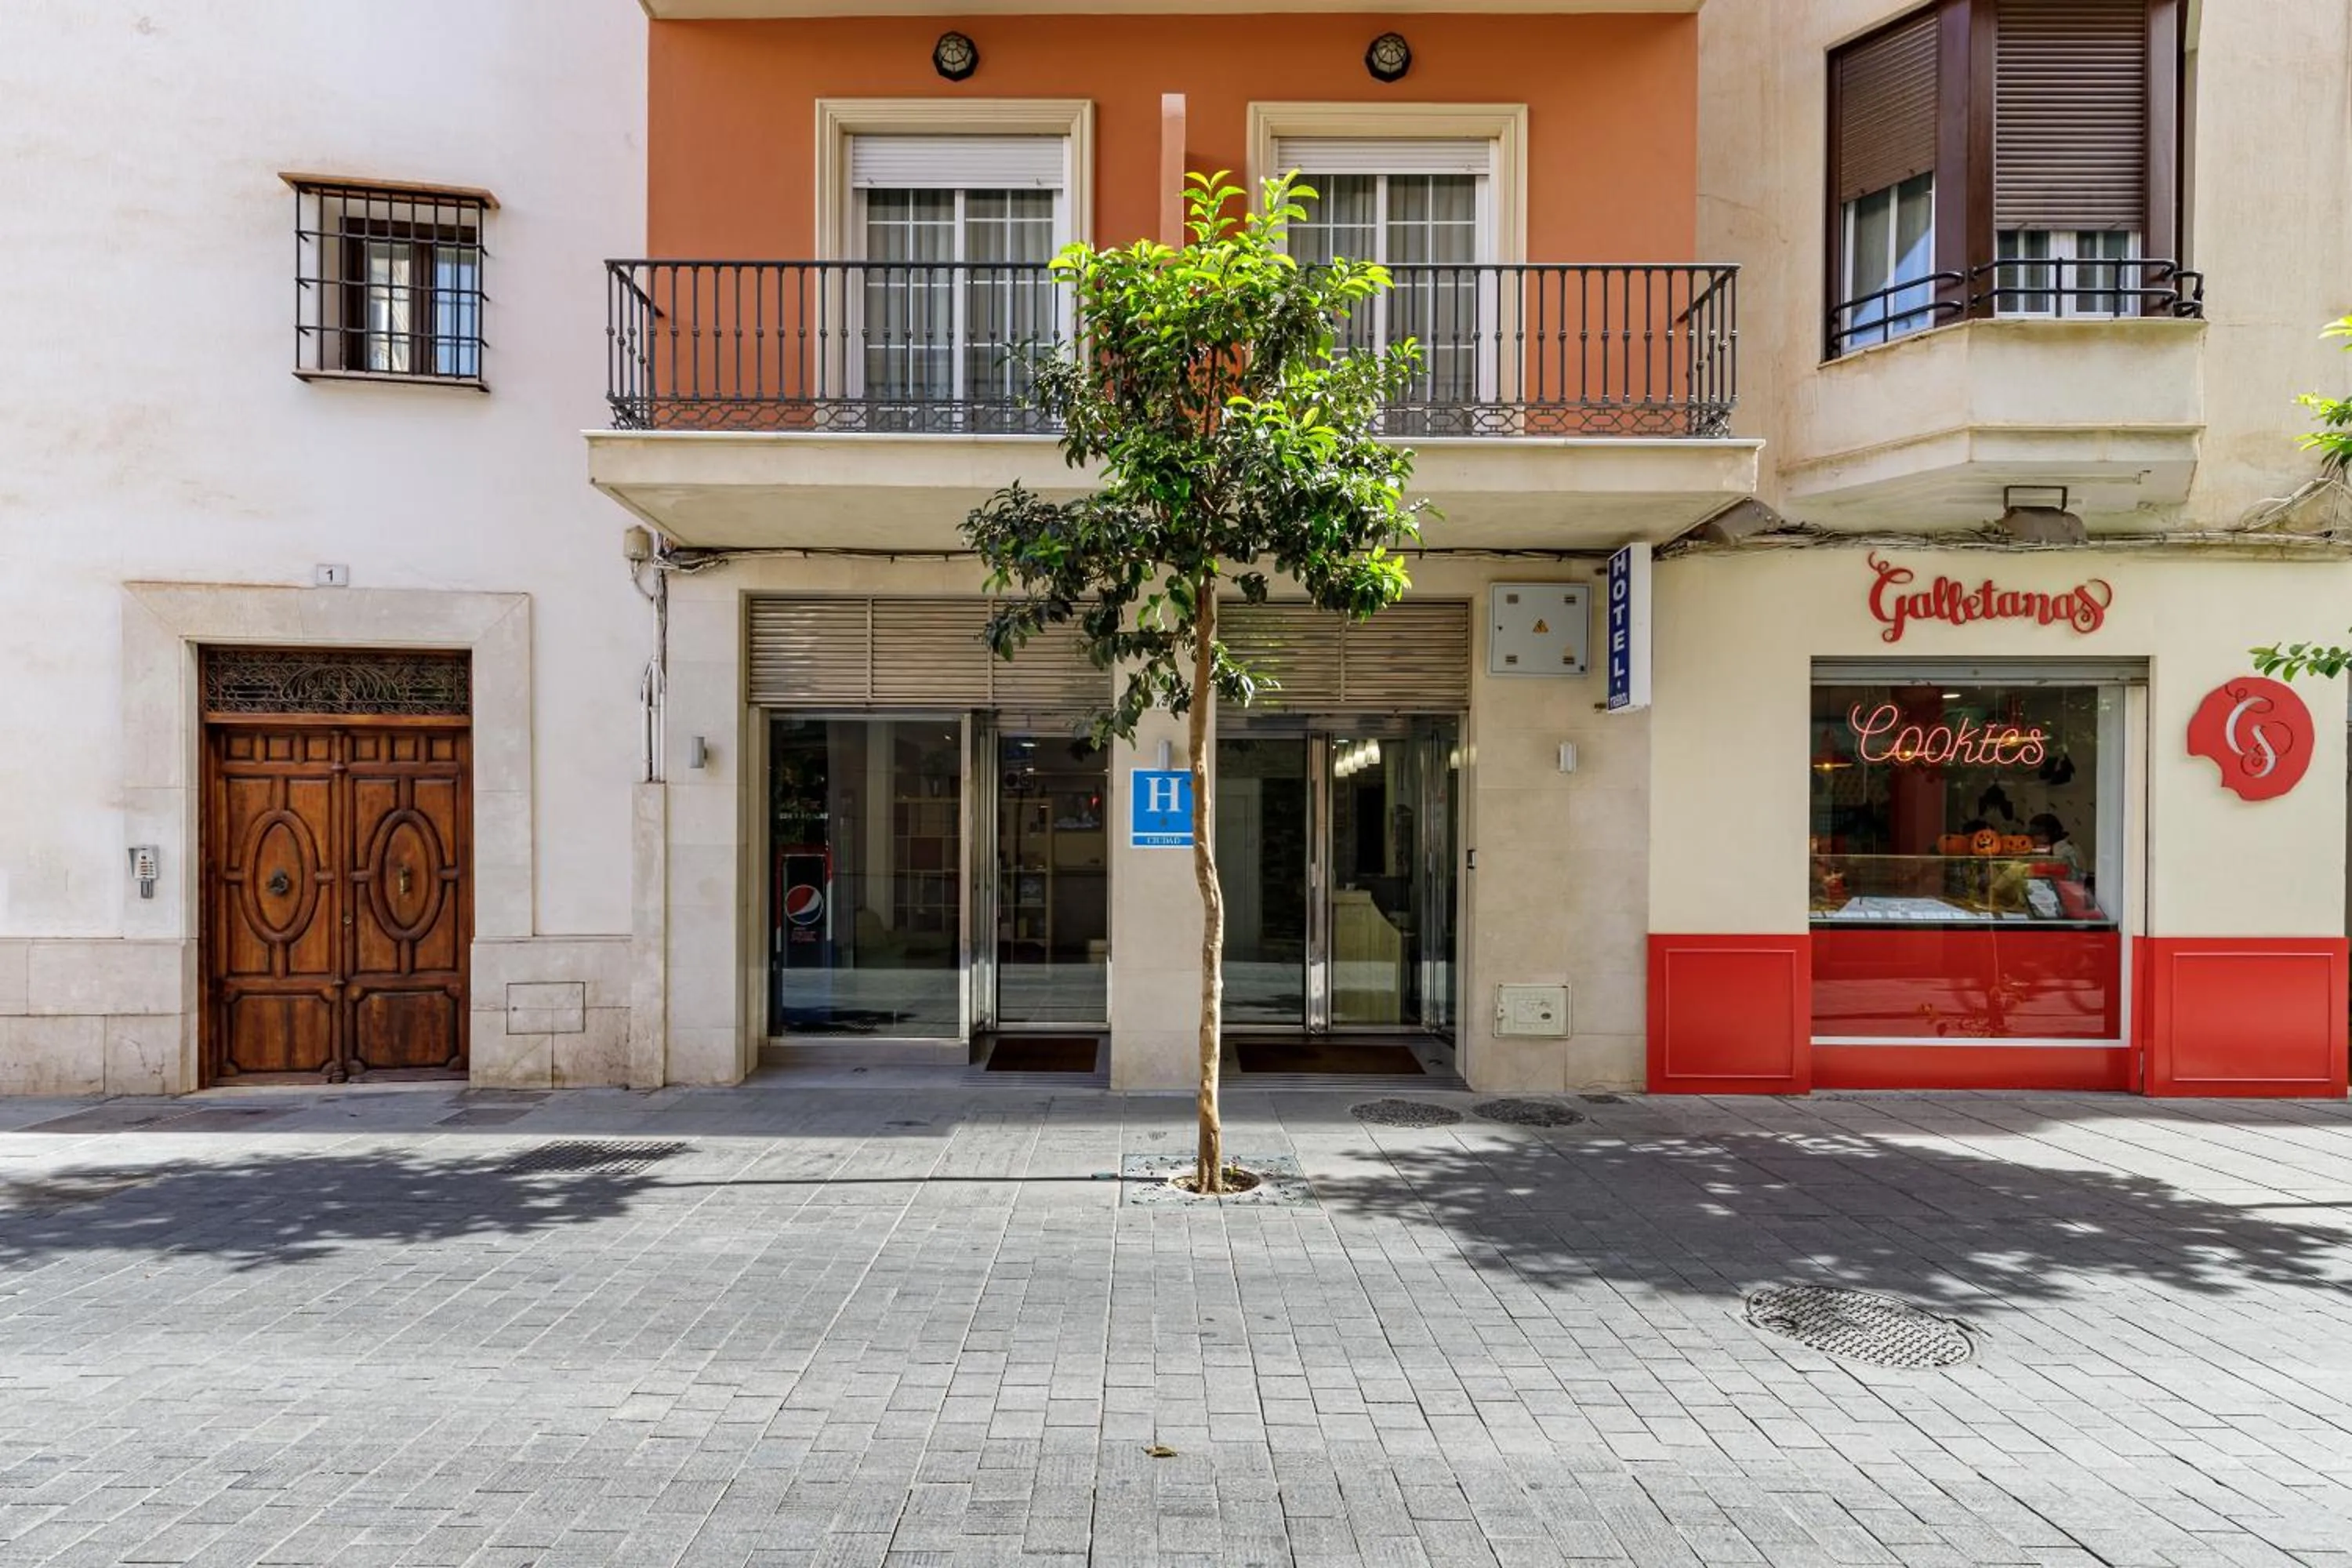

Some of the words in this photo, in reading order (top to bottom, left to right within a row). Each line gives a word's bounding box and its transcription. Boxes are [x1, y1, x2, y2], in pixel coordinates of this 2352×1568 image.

[326, 569, 333, 582] 1
[1867, 551, 2113, 642] Galletanas
[1613, 552, 1626, 677] HOTEL
[1852, 705, 2045, 764] Cookies
[1145, 777, 1182, 813] H
